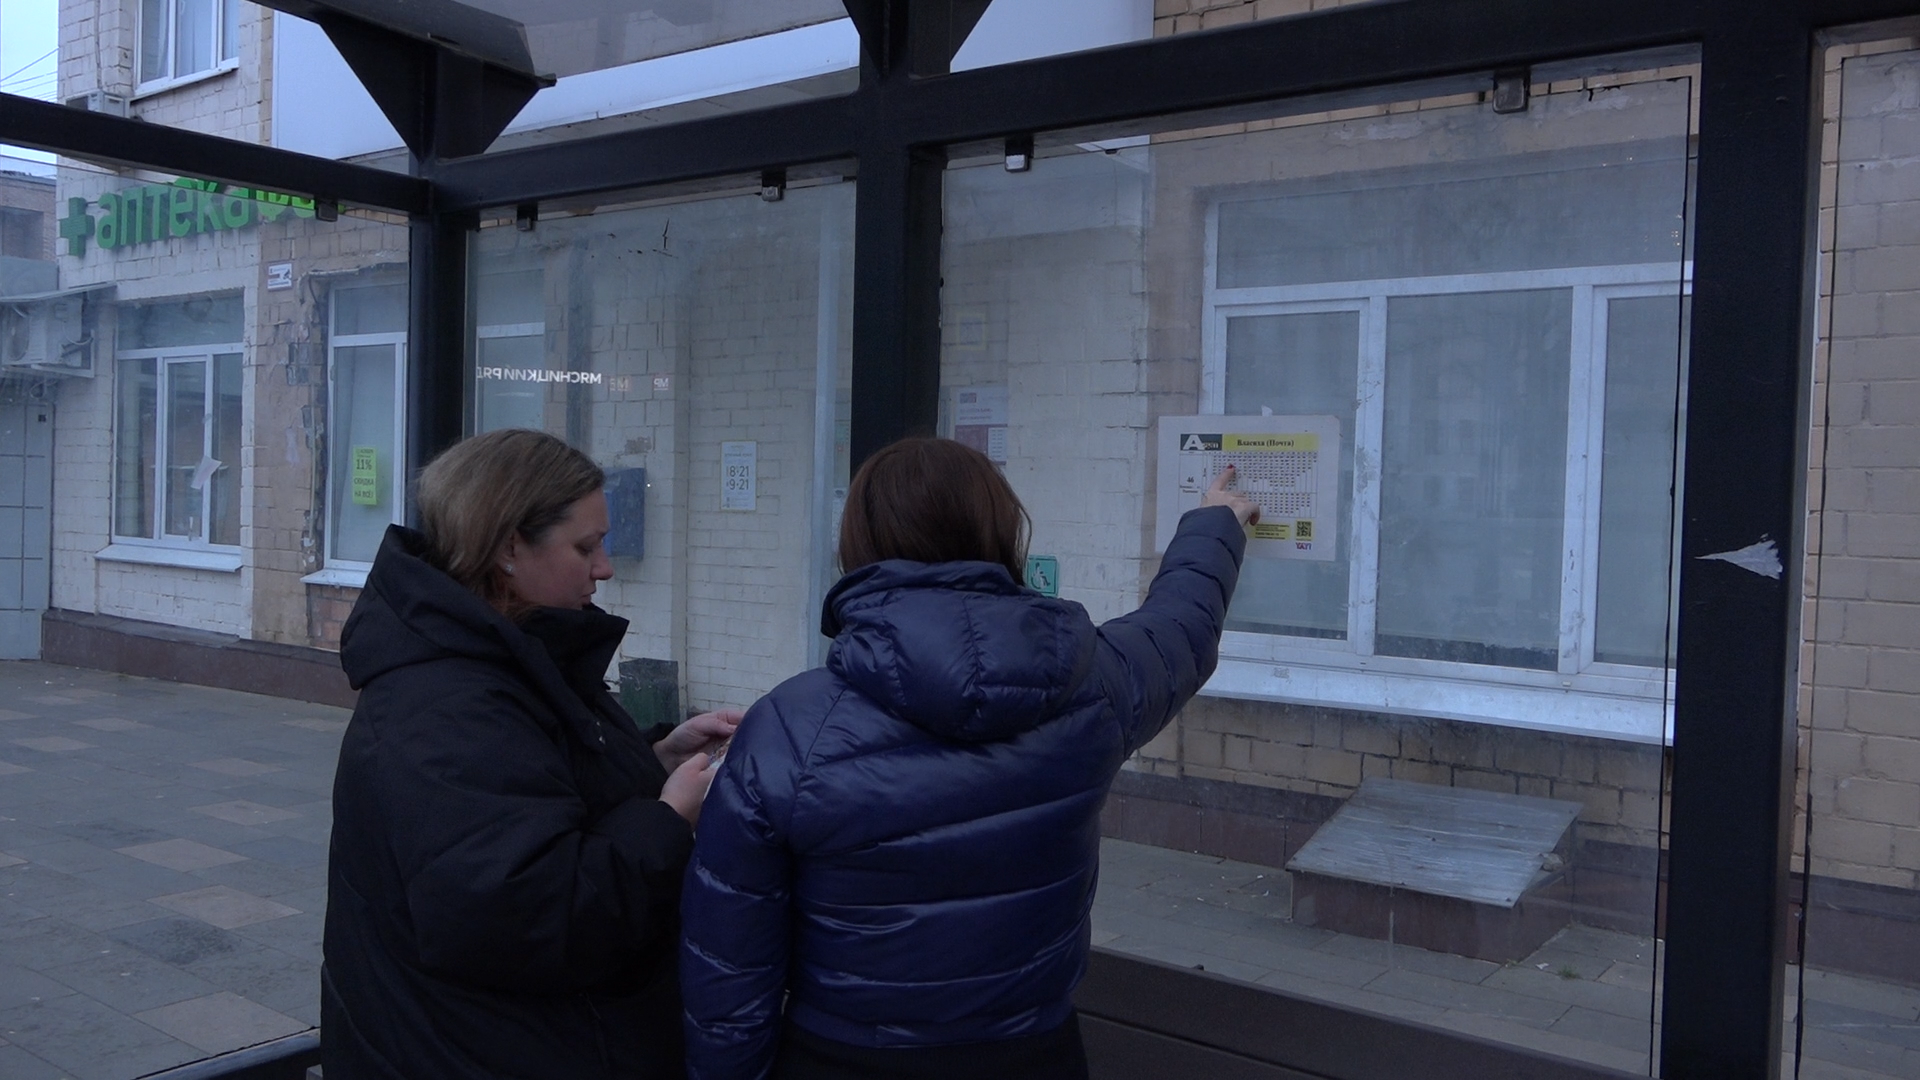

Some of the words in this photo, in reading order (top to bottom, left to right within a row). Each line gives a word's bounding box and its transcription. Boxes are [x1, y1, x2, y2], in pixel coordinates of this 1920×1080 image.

[96, 177, 252, 249] аптека
[1266, 439, 1295, 447] (Почта)
[356, 459, 372, 470] 11%
